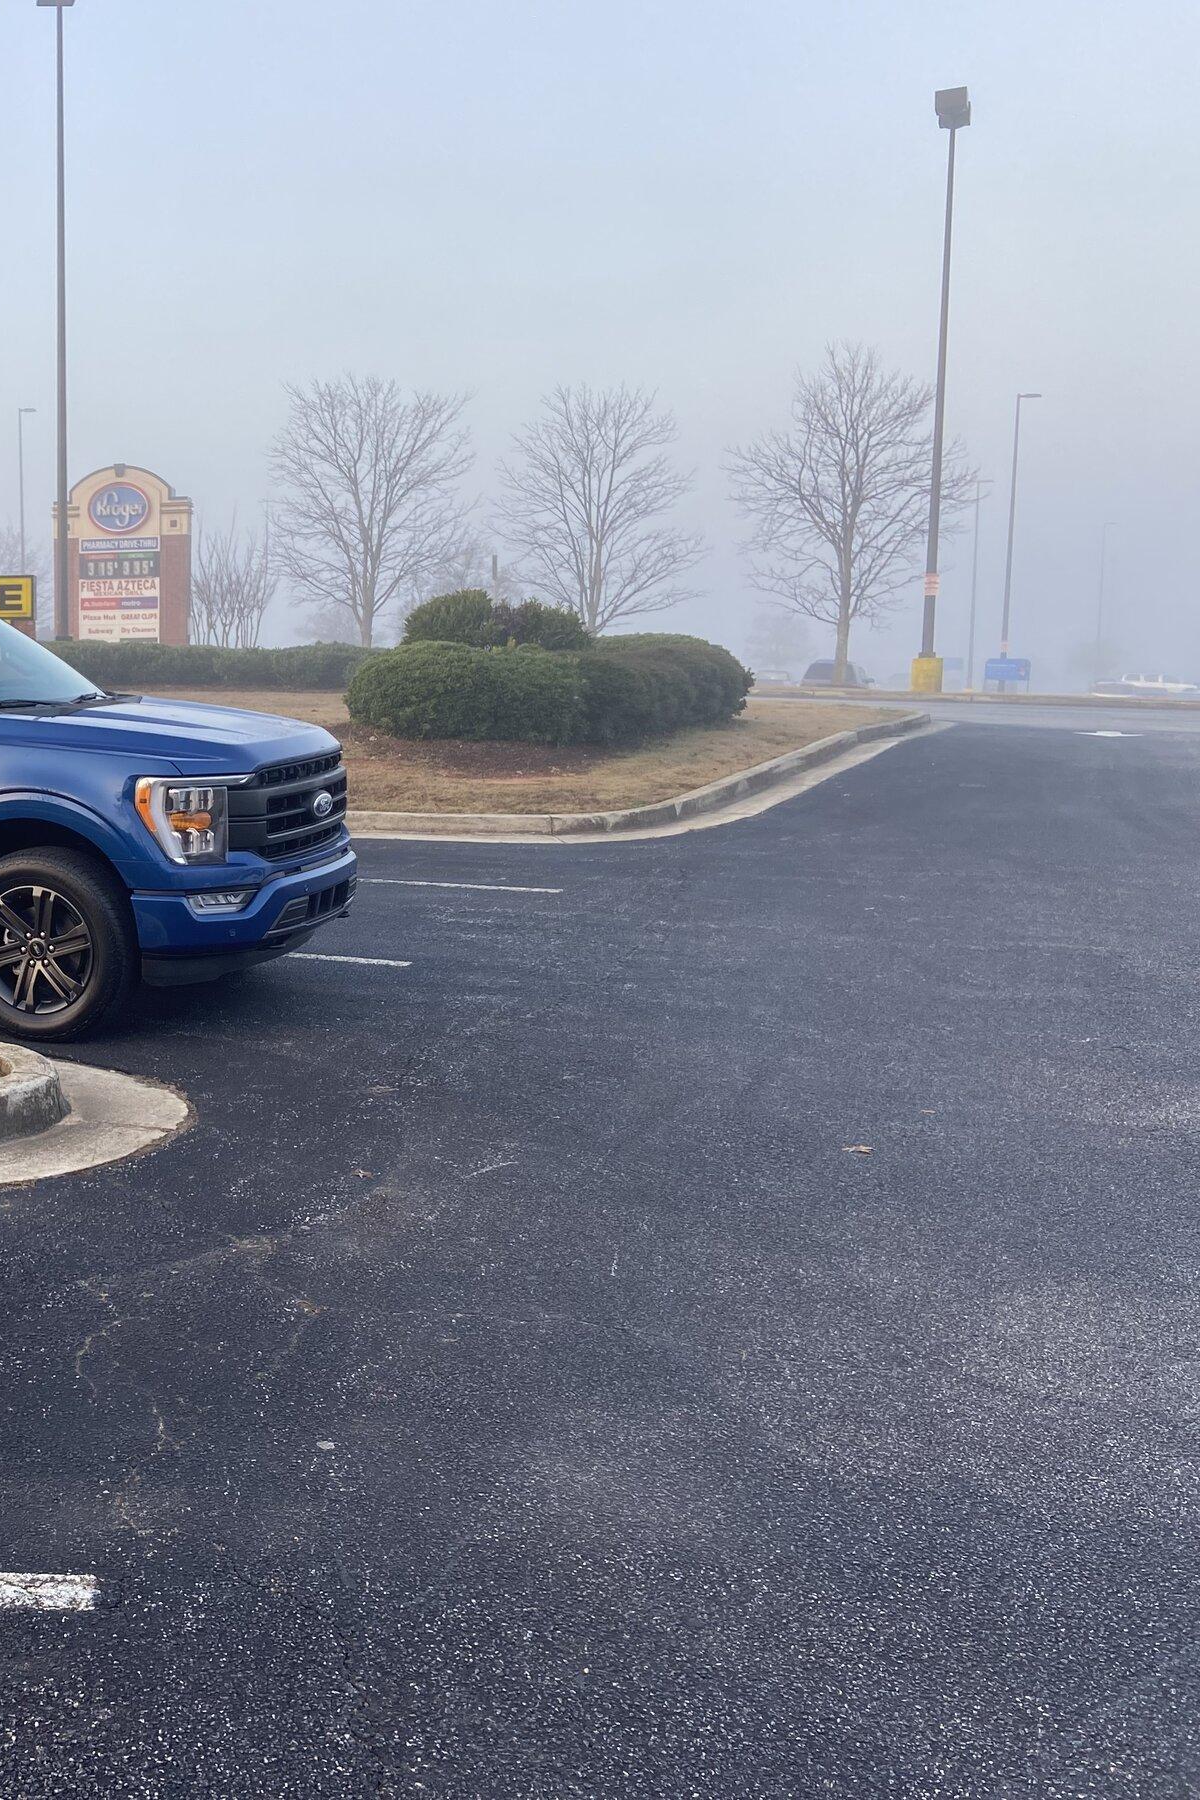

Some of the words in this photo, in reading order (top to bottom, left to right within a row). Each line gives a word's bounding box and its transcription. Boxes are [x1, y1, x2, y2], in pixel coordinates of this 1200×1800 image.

[96, 491, 142, 527] Kroger
[82, 540, 118, 550] PHARMACY
[80, 581, 114, 592] FIESTA
[117, 579, 157, 591] AZTECA
